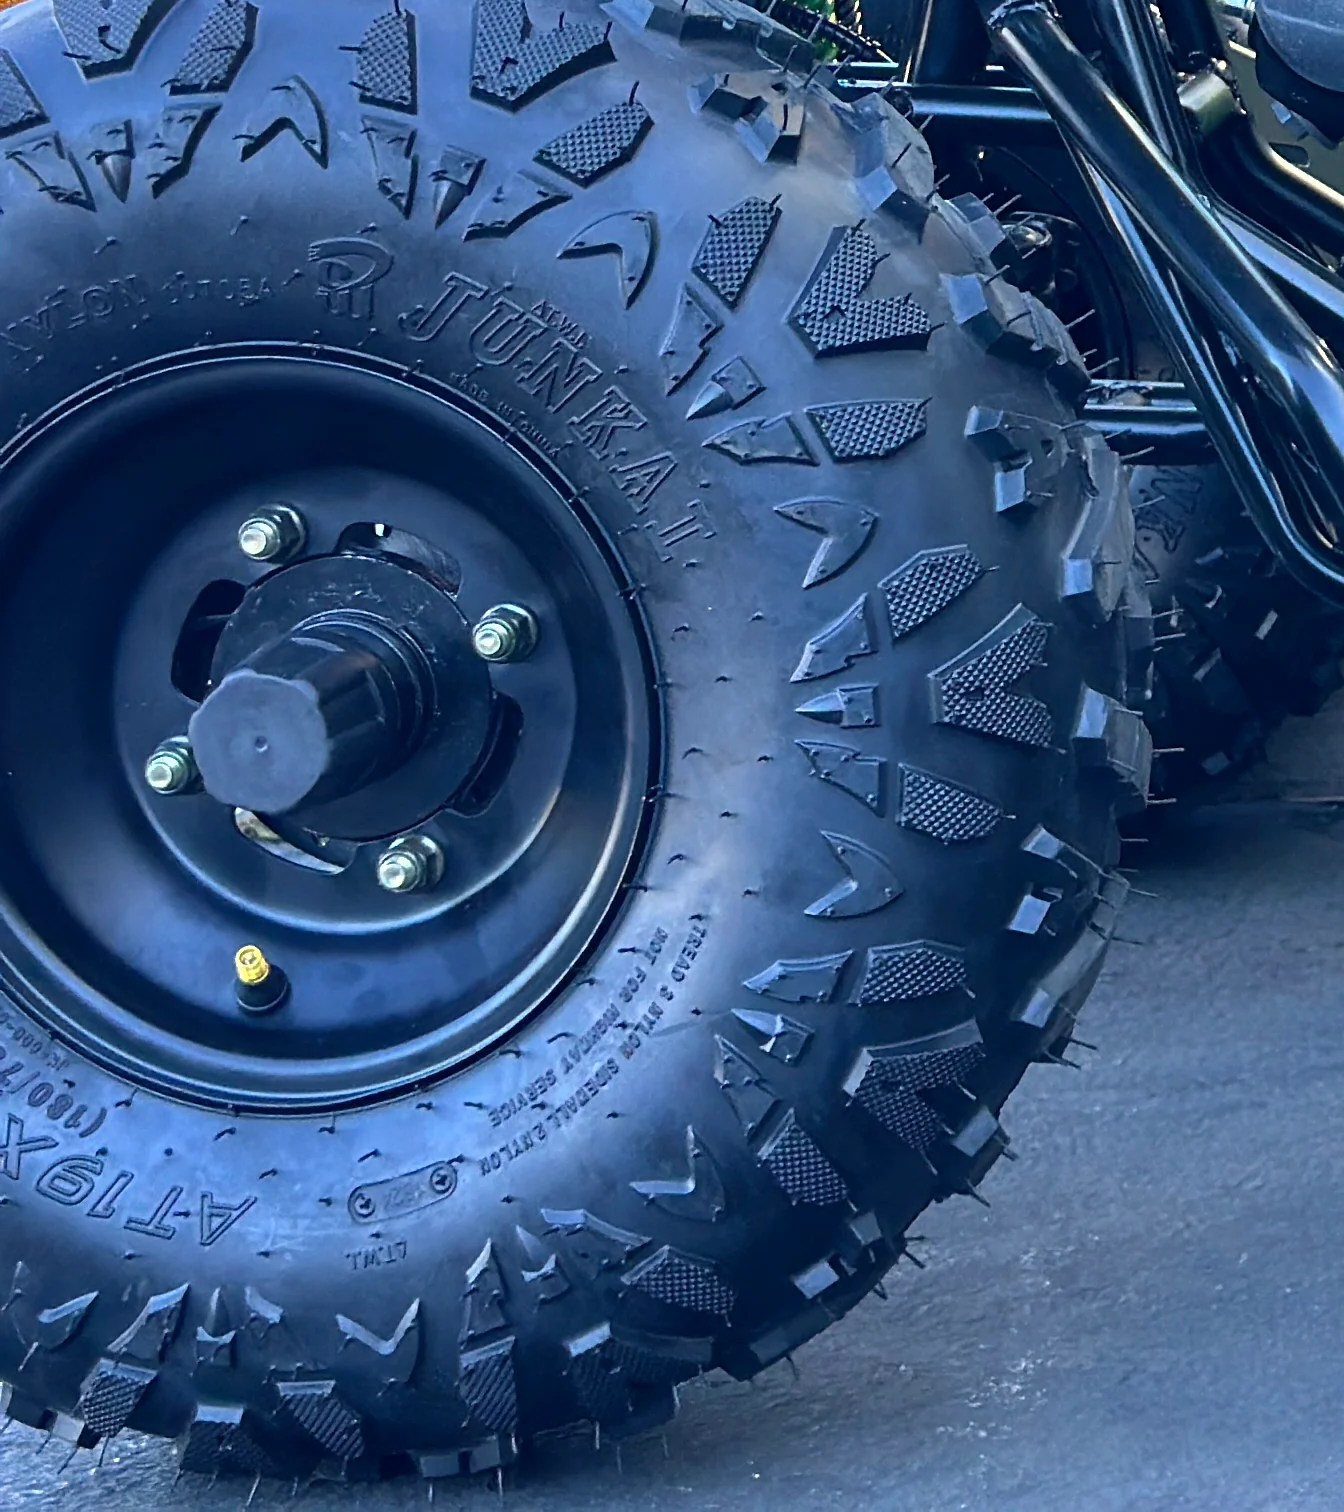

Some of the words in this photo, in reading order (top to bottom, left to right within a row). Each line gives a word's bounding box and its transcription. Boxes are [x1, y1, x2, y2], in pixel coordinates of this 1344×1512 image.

[398, 270, 716, 563] JUNKAI
[0, 1047, 107, 1139] (180/7
[488, 1069, 557, 1126] SERVICE
